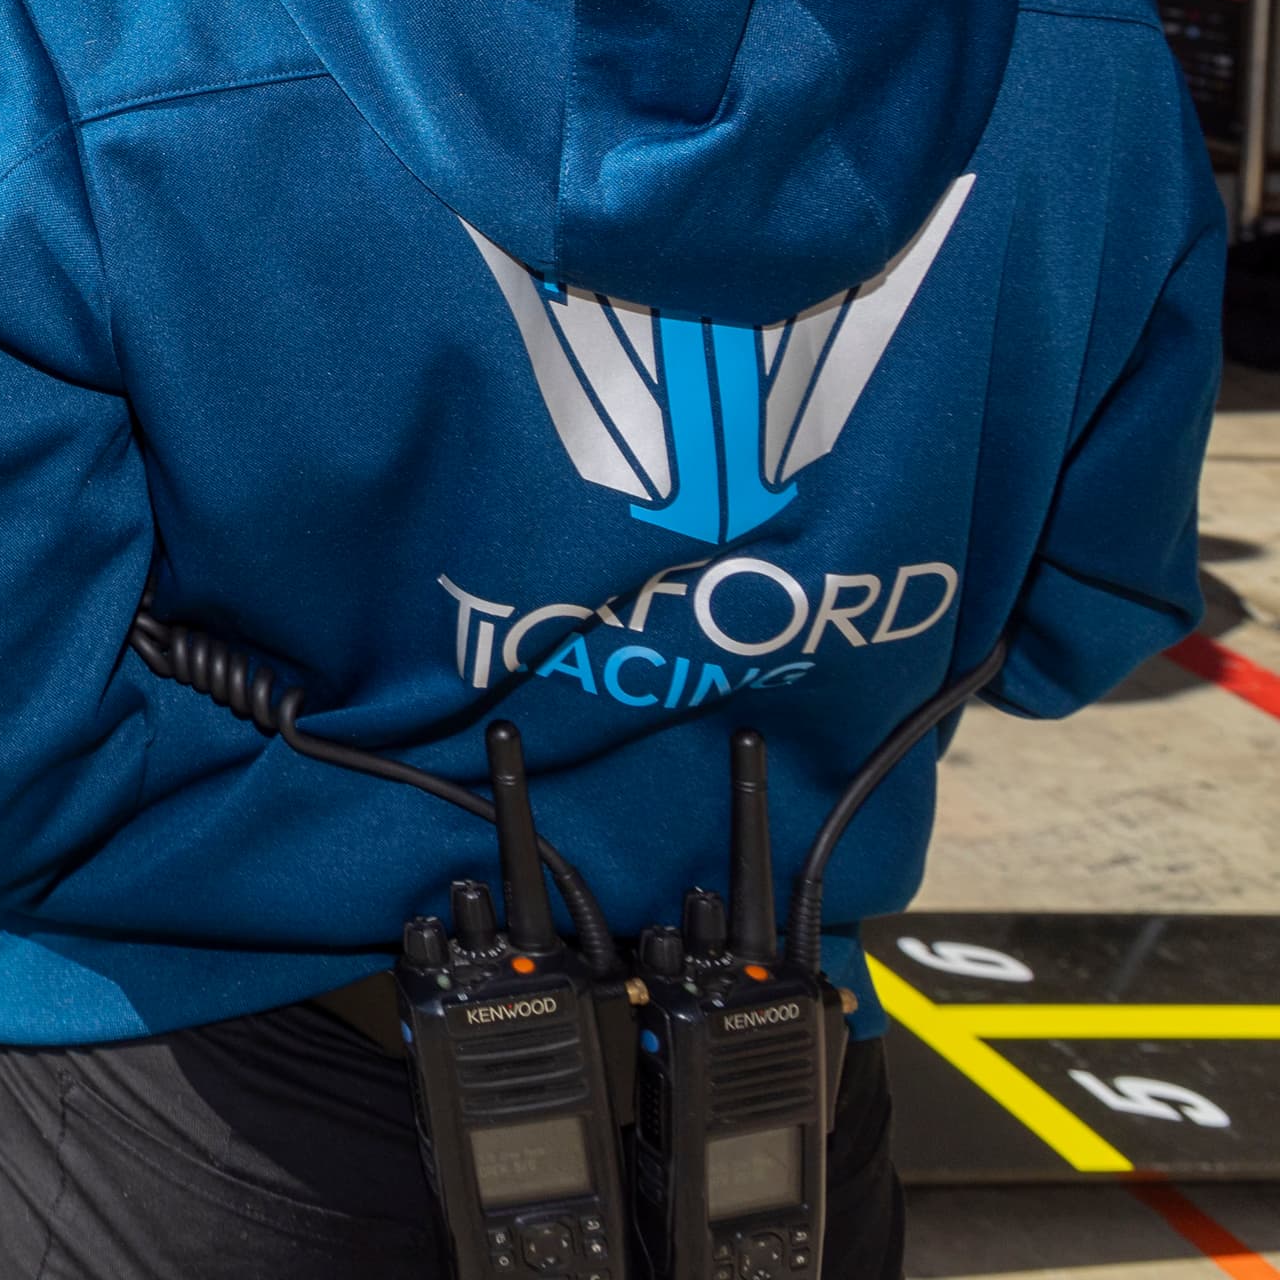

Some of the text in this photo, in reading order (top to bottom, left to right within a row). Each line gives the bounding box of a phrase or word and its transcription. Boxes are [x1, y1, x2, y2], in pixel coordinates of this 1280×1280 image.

[535, 632, 817, 709] ACING
[467, 996, 558, 1024] KENWOOD
[724, 1002, 801, 1032] KENWOOD
[1068, 1068, 1231, 1129] 5
